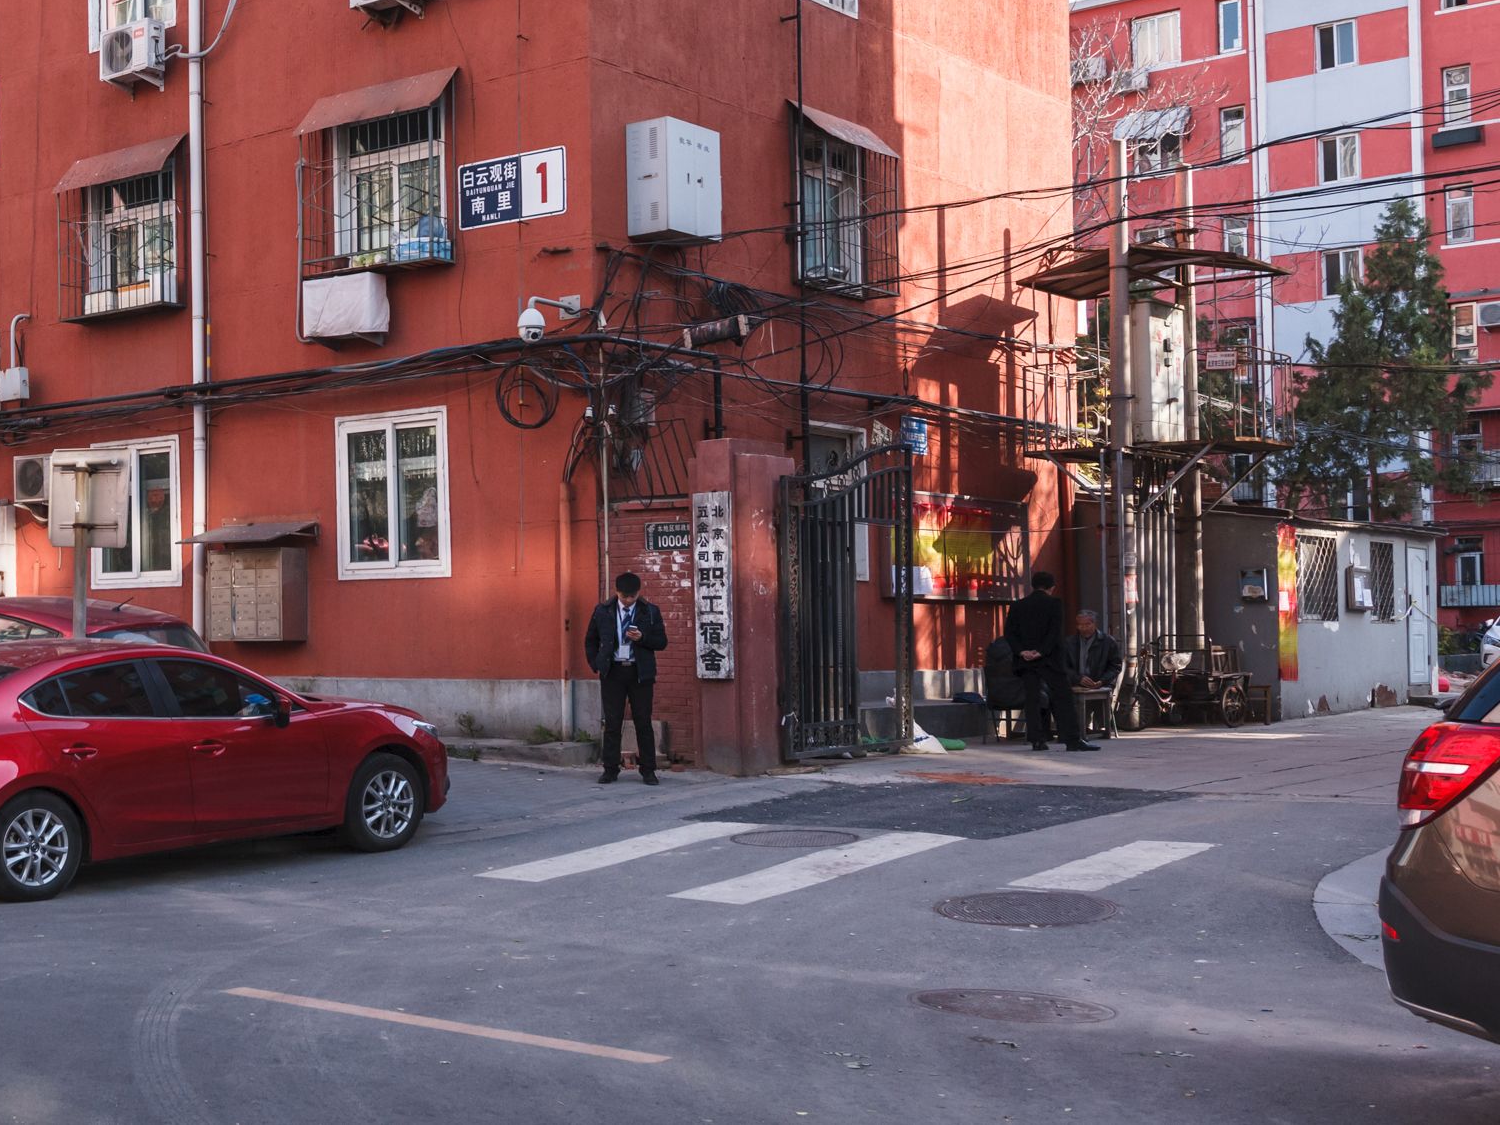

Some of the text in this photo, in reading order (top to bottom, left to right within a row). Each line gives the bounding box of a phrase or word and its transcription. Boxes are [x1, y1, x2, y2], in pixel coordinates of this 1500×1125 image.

[463, 162, 517, 188] 白云观街
[506, 181, 515, 189] JIE
[536, 162, 547, 204] 1
[471, 191, 512, 215] 南里
[481, 213, 501, 222] NANLI
[658, 535, 690, 548] 10004
[697, 505, 709, 562] 五金公司
[712, 505, 724, 562] 北京市
[699, 567, 725, 672] 职工宿舍
